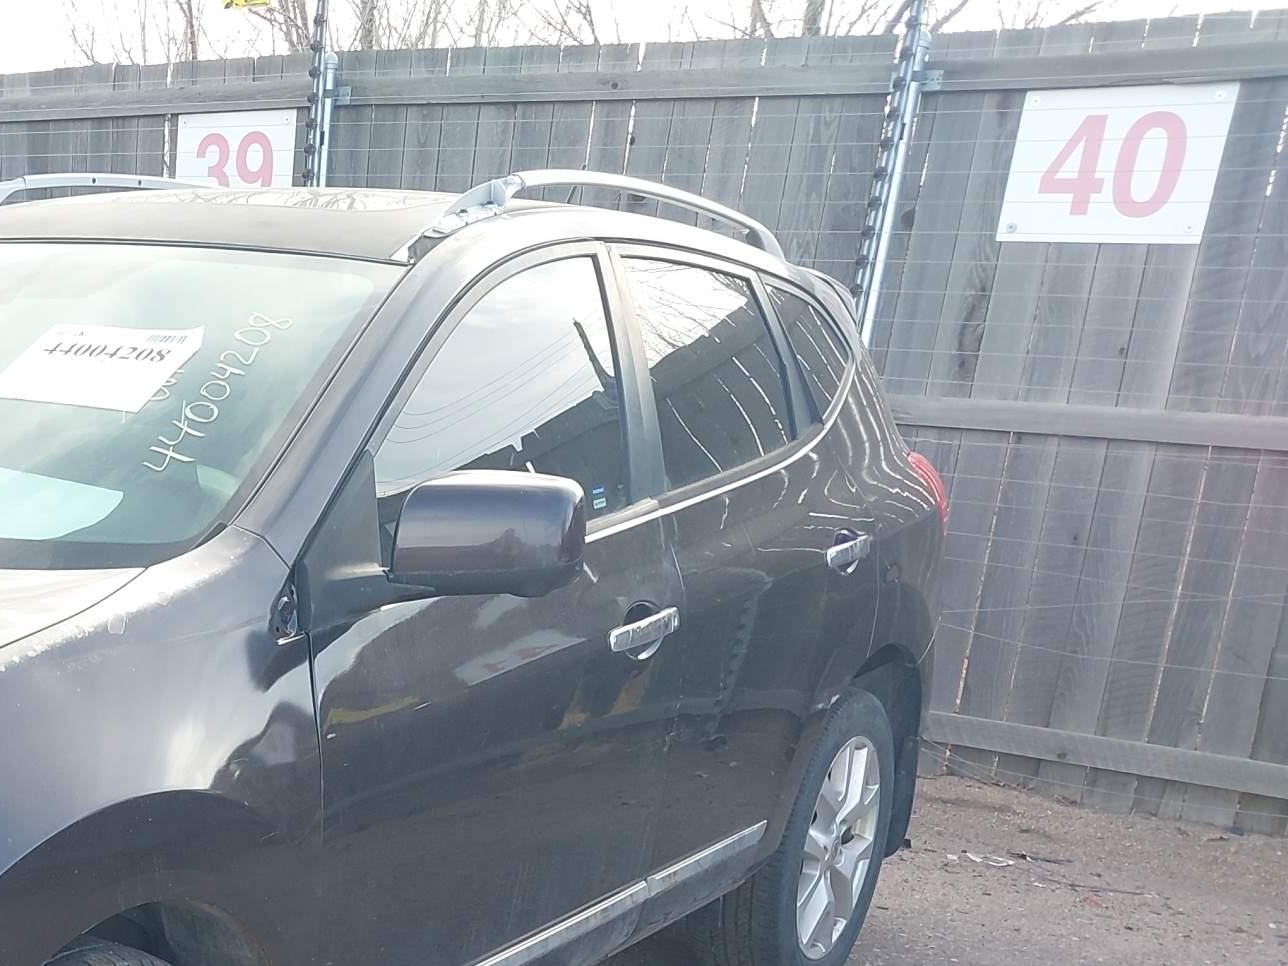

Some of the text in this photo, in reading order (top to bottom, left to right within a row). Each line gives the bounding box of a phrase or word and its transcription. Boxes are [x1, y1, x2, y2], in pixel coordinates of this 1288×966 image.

[195, 130, 275, 188] 39
[1037, 110, 1188, 219] 40
[44, 341, 172, 362] 44004208
[143, 311, 293, 473] 44004208
